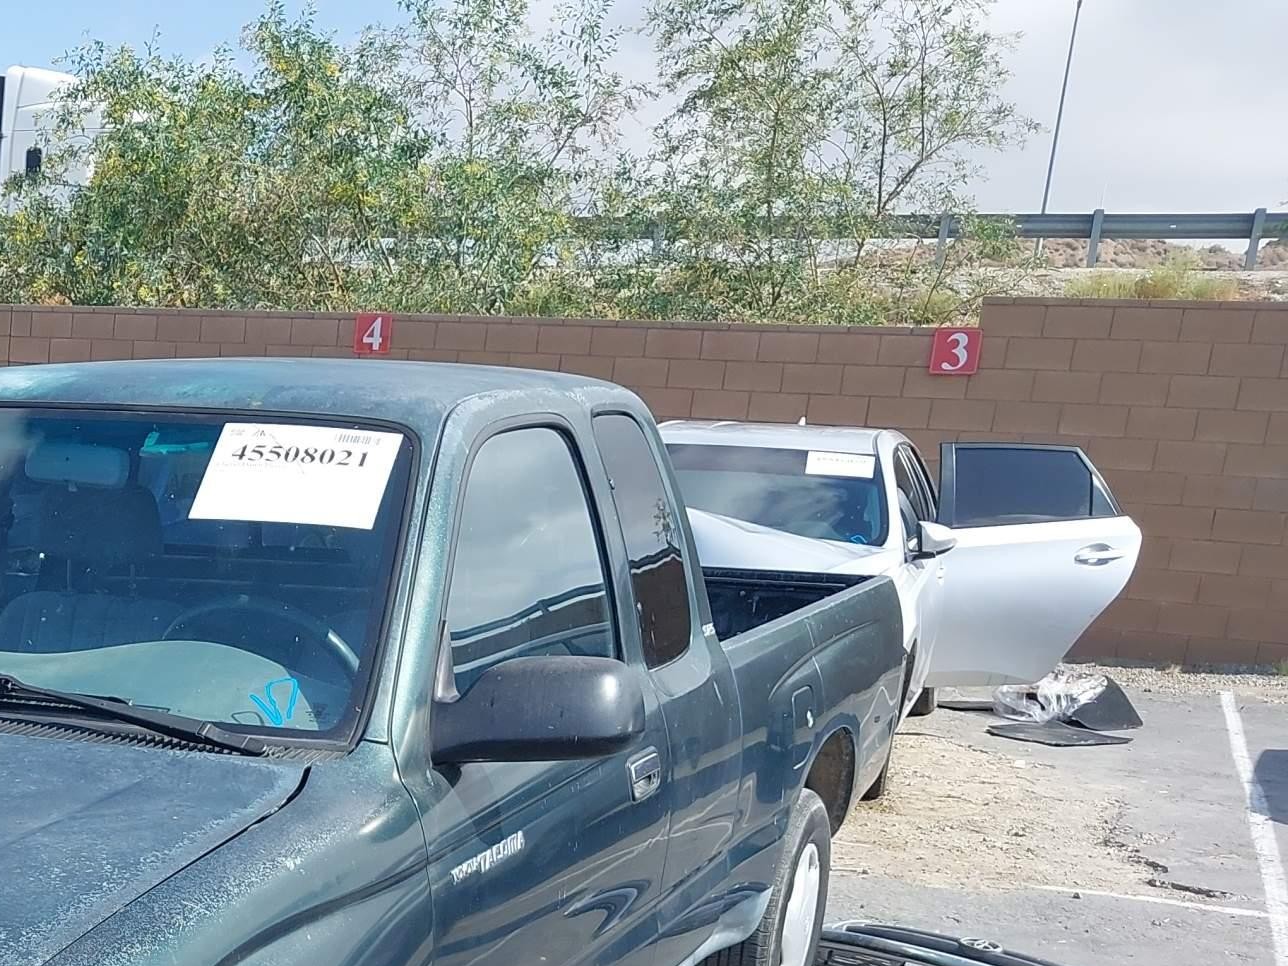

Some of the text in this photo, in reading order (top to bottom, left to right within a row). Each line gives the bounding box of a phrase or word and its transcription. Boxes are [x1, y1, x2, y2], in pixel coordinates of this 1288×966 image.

[362, 316, 383, 351] 4
[940, 332, 969, 371] 3
[231, 443, 369, 467] 45508021
